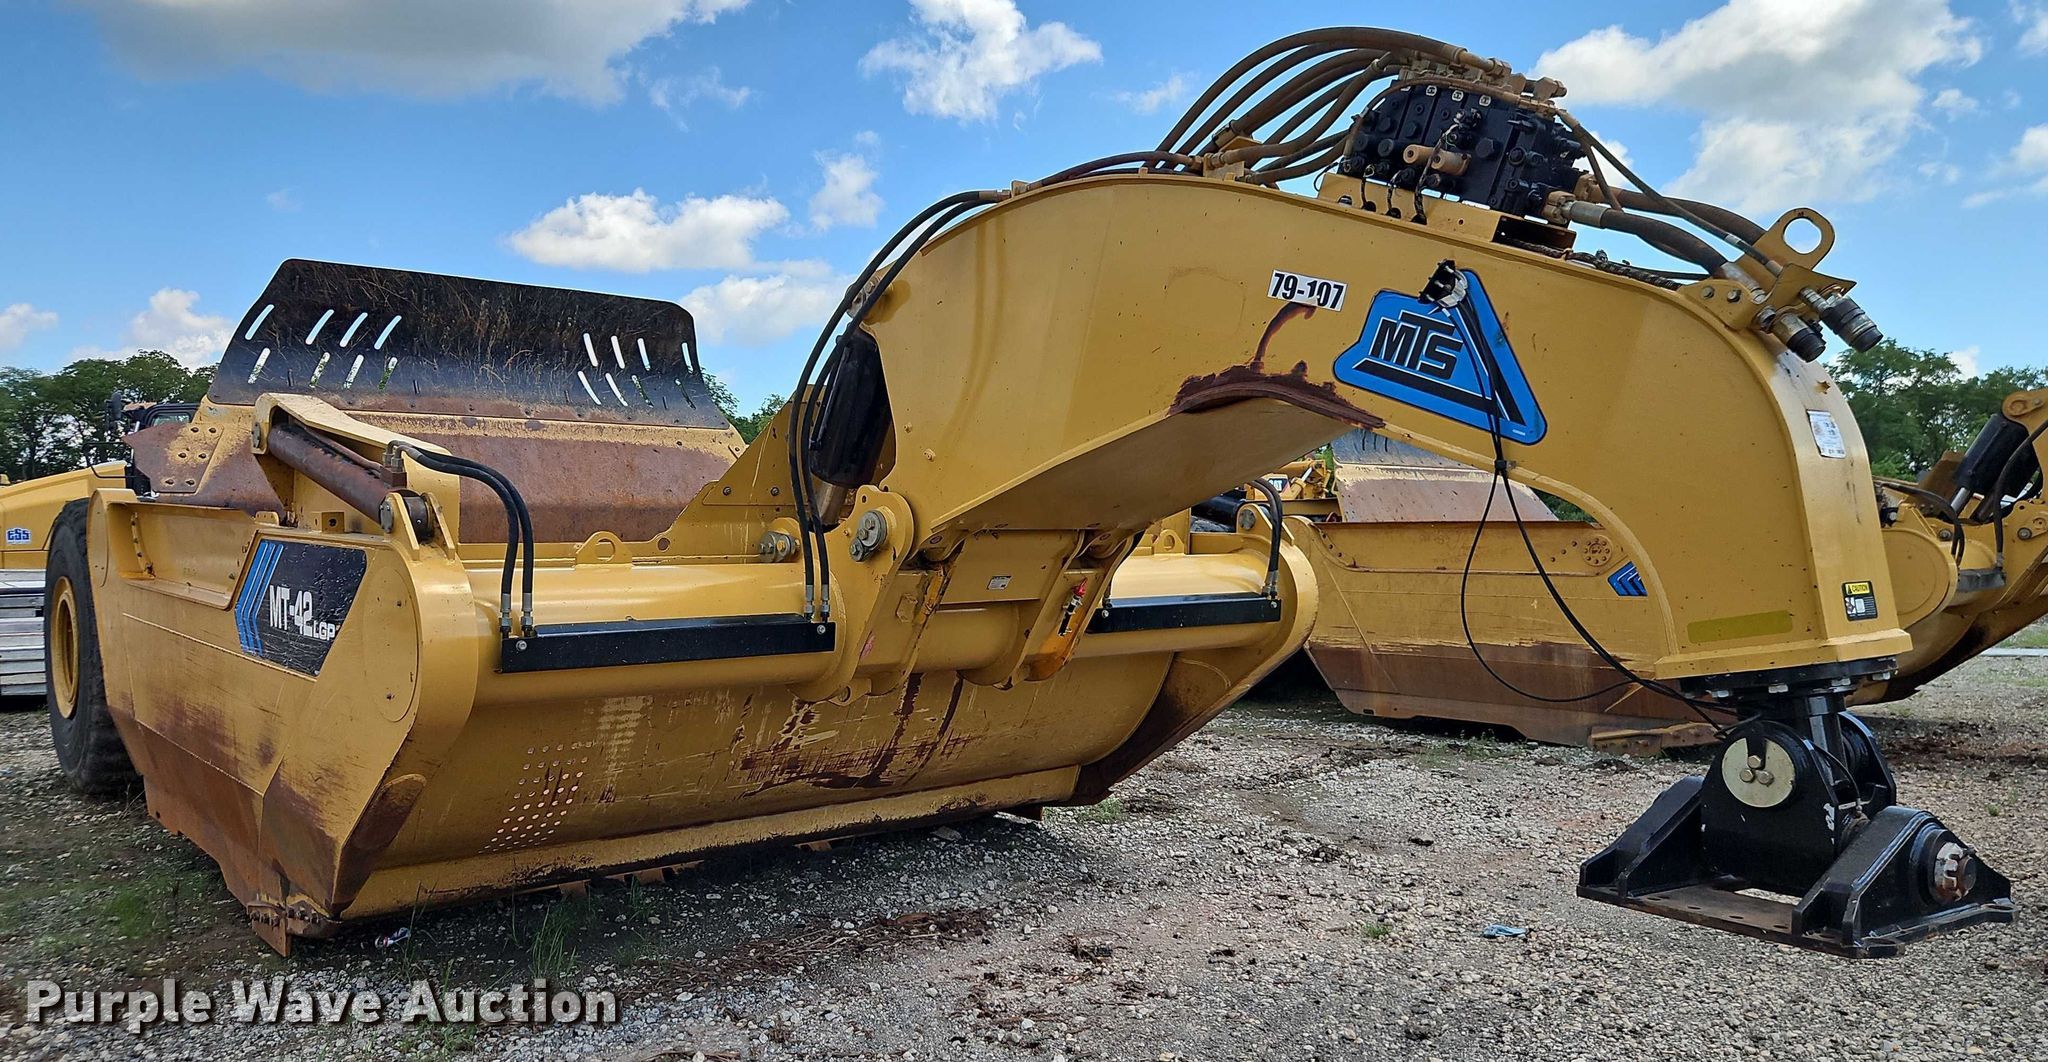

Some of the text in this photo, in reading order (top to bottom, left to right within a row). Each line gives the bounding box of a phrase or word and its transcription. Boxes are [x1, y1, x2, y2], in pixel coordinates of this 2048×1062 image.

[1271, 272, 1345, 309] 79-107
[1368, 309, 1464, 381] MTS
[269, 585, 313, 637] MT-42
